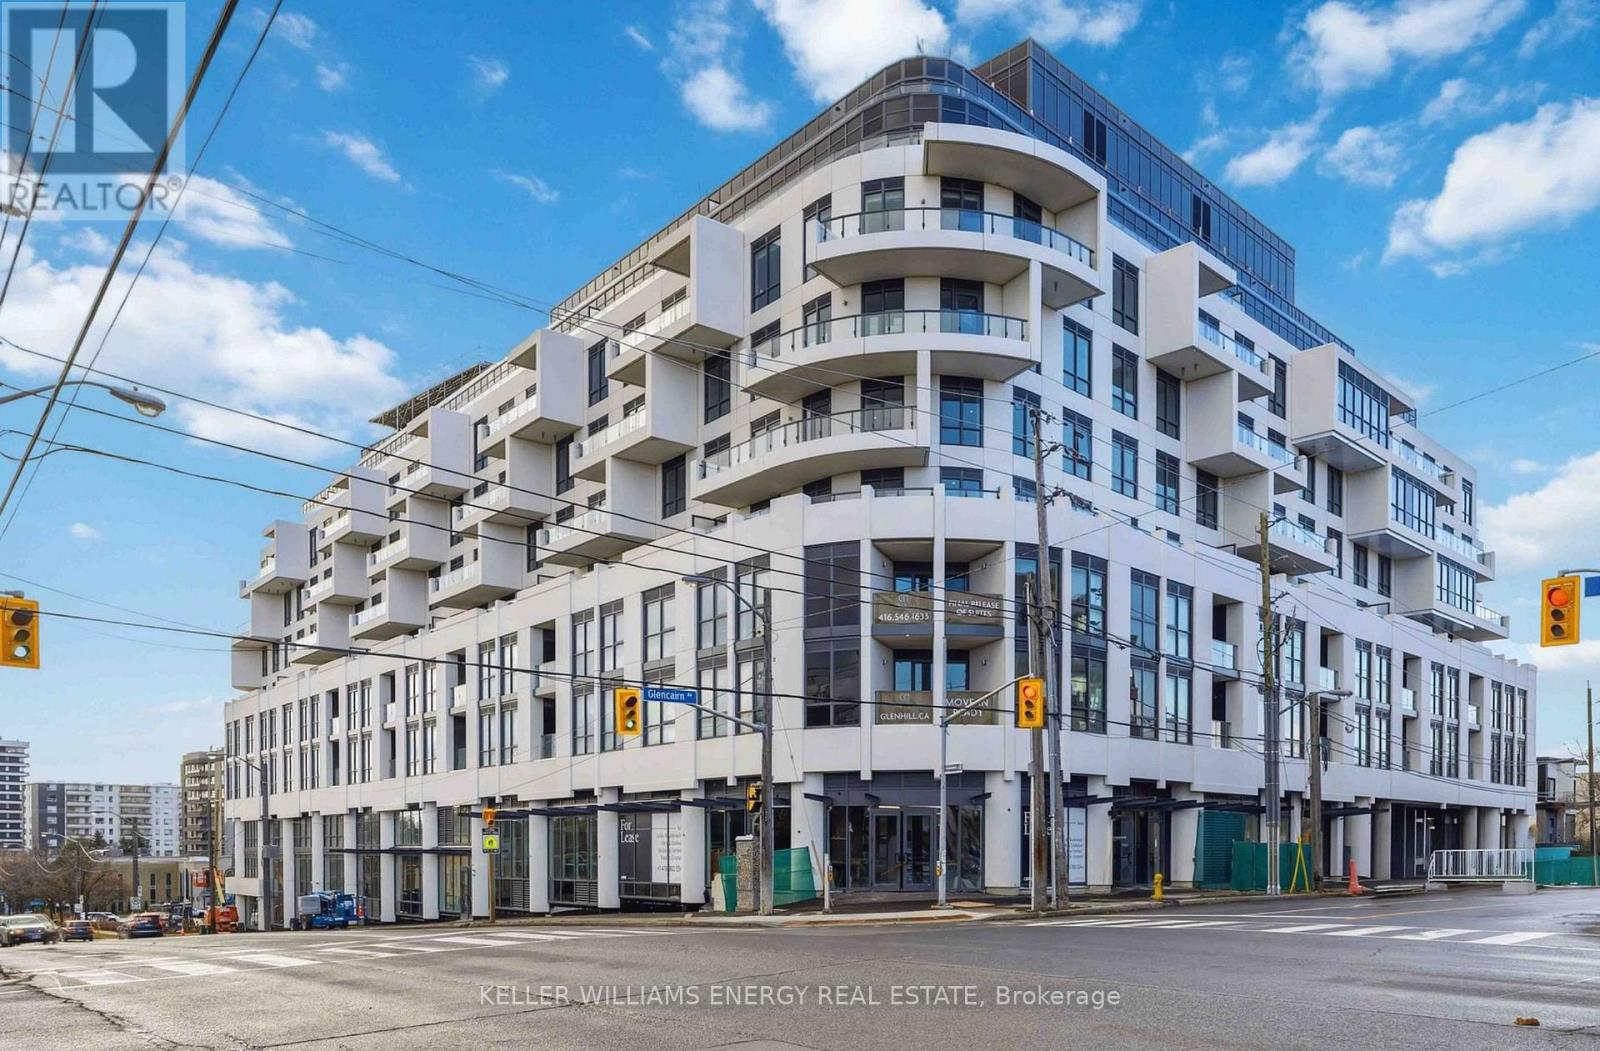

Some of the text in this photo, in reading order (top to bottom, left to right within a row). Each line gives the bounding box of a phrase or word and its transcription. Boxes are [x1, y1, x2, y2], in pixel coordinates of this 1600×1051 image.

[647, 689, 685, 700] Glencairn
[880, 712, 930, 721] GLENHILL.CA
[953, 708, 983, 717] RADY
[620, 818, 633, 831] For
[620, 831, 640, 843] Lease
